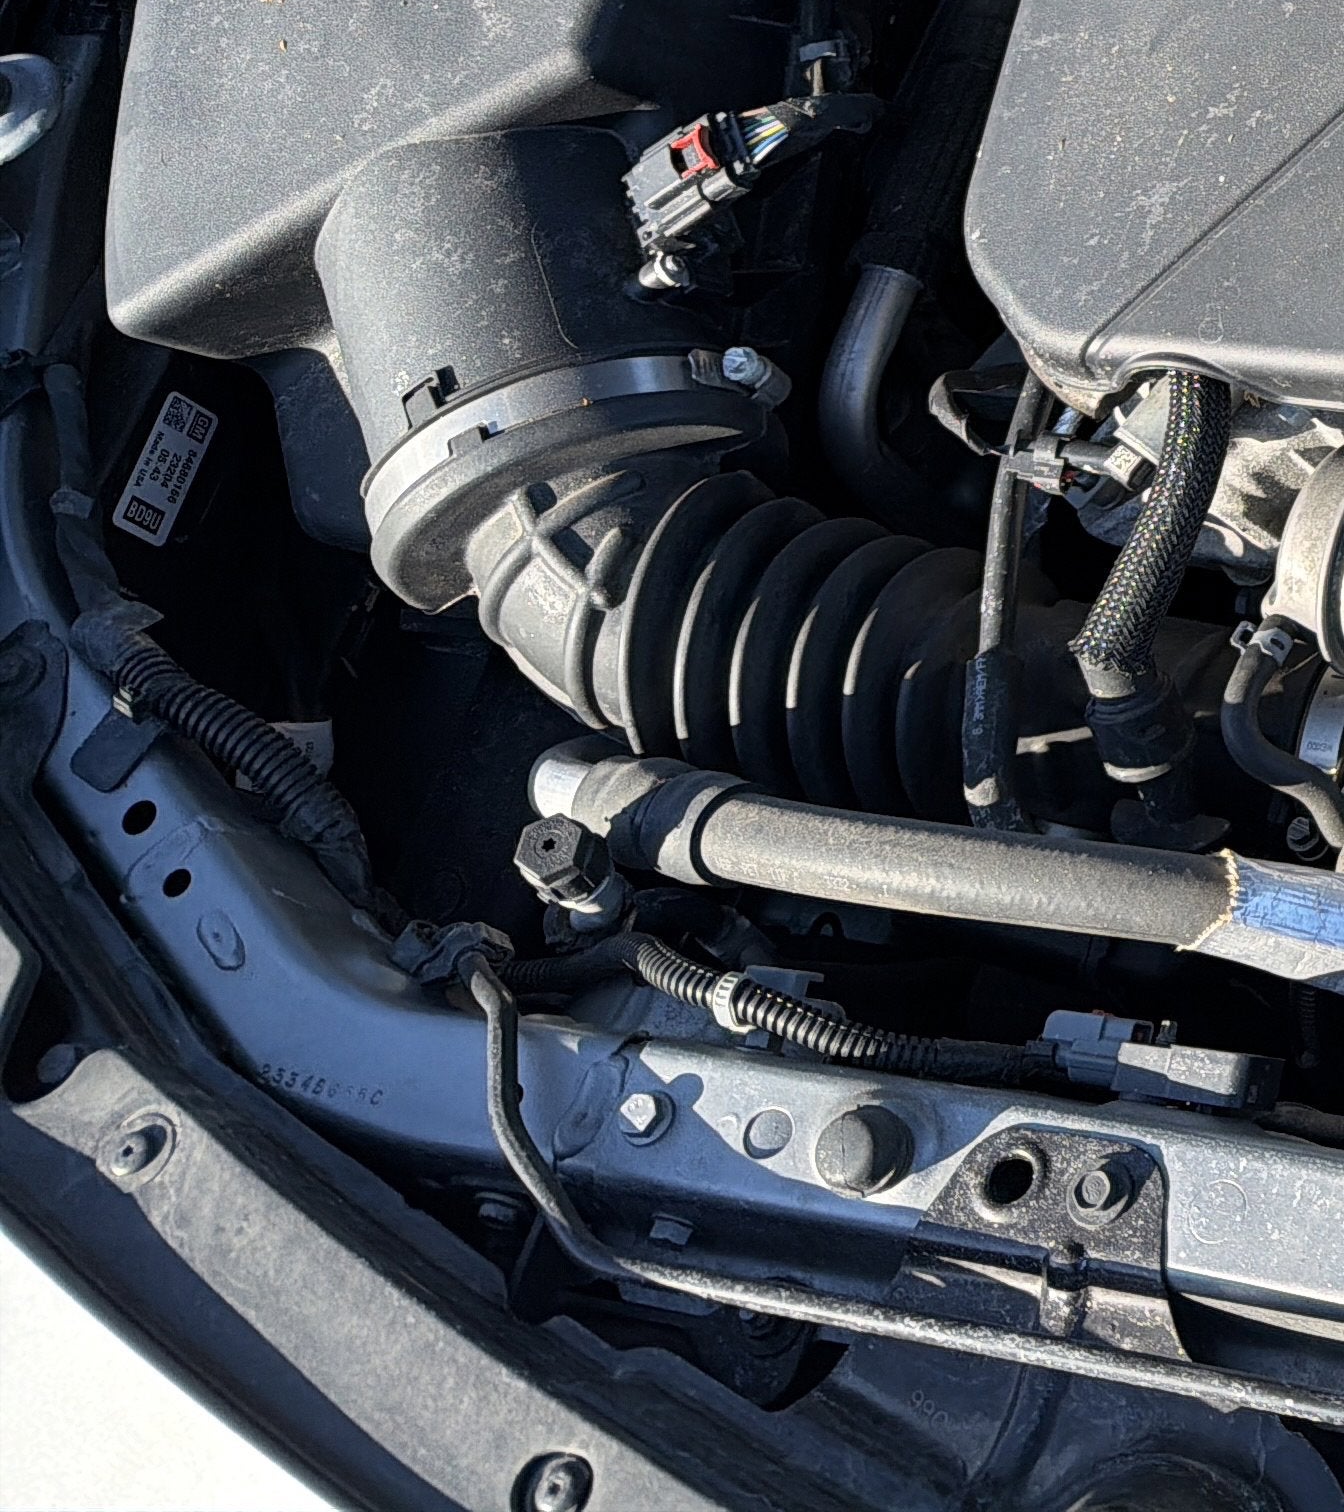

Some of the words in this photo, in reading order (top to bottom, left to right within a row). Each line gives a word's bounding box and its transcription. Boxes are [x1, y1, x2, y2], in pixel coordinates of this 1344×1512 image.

[189, 416, 209, 441] GM
[134, 468, 148, 487] USA
[126, 500, 162, 530] BD9U
